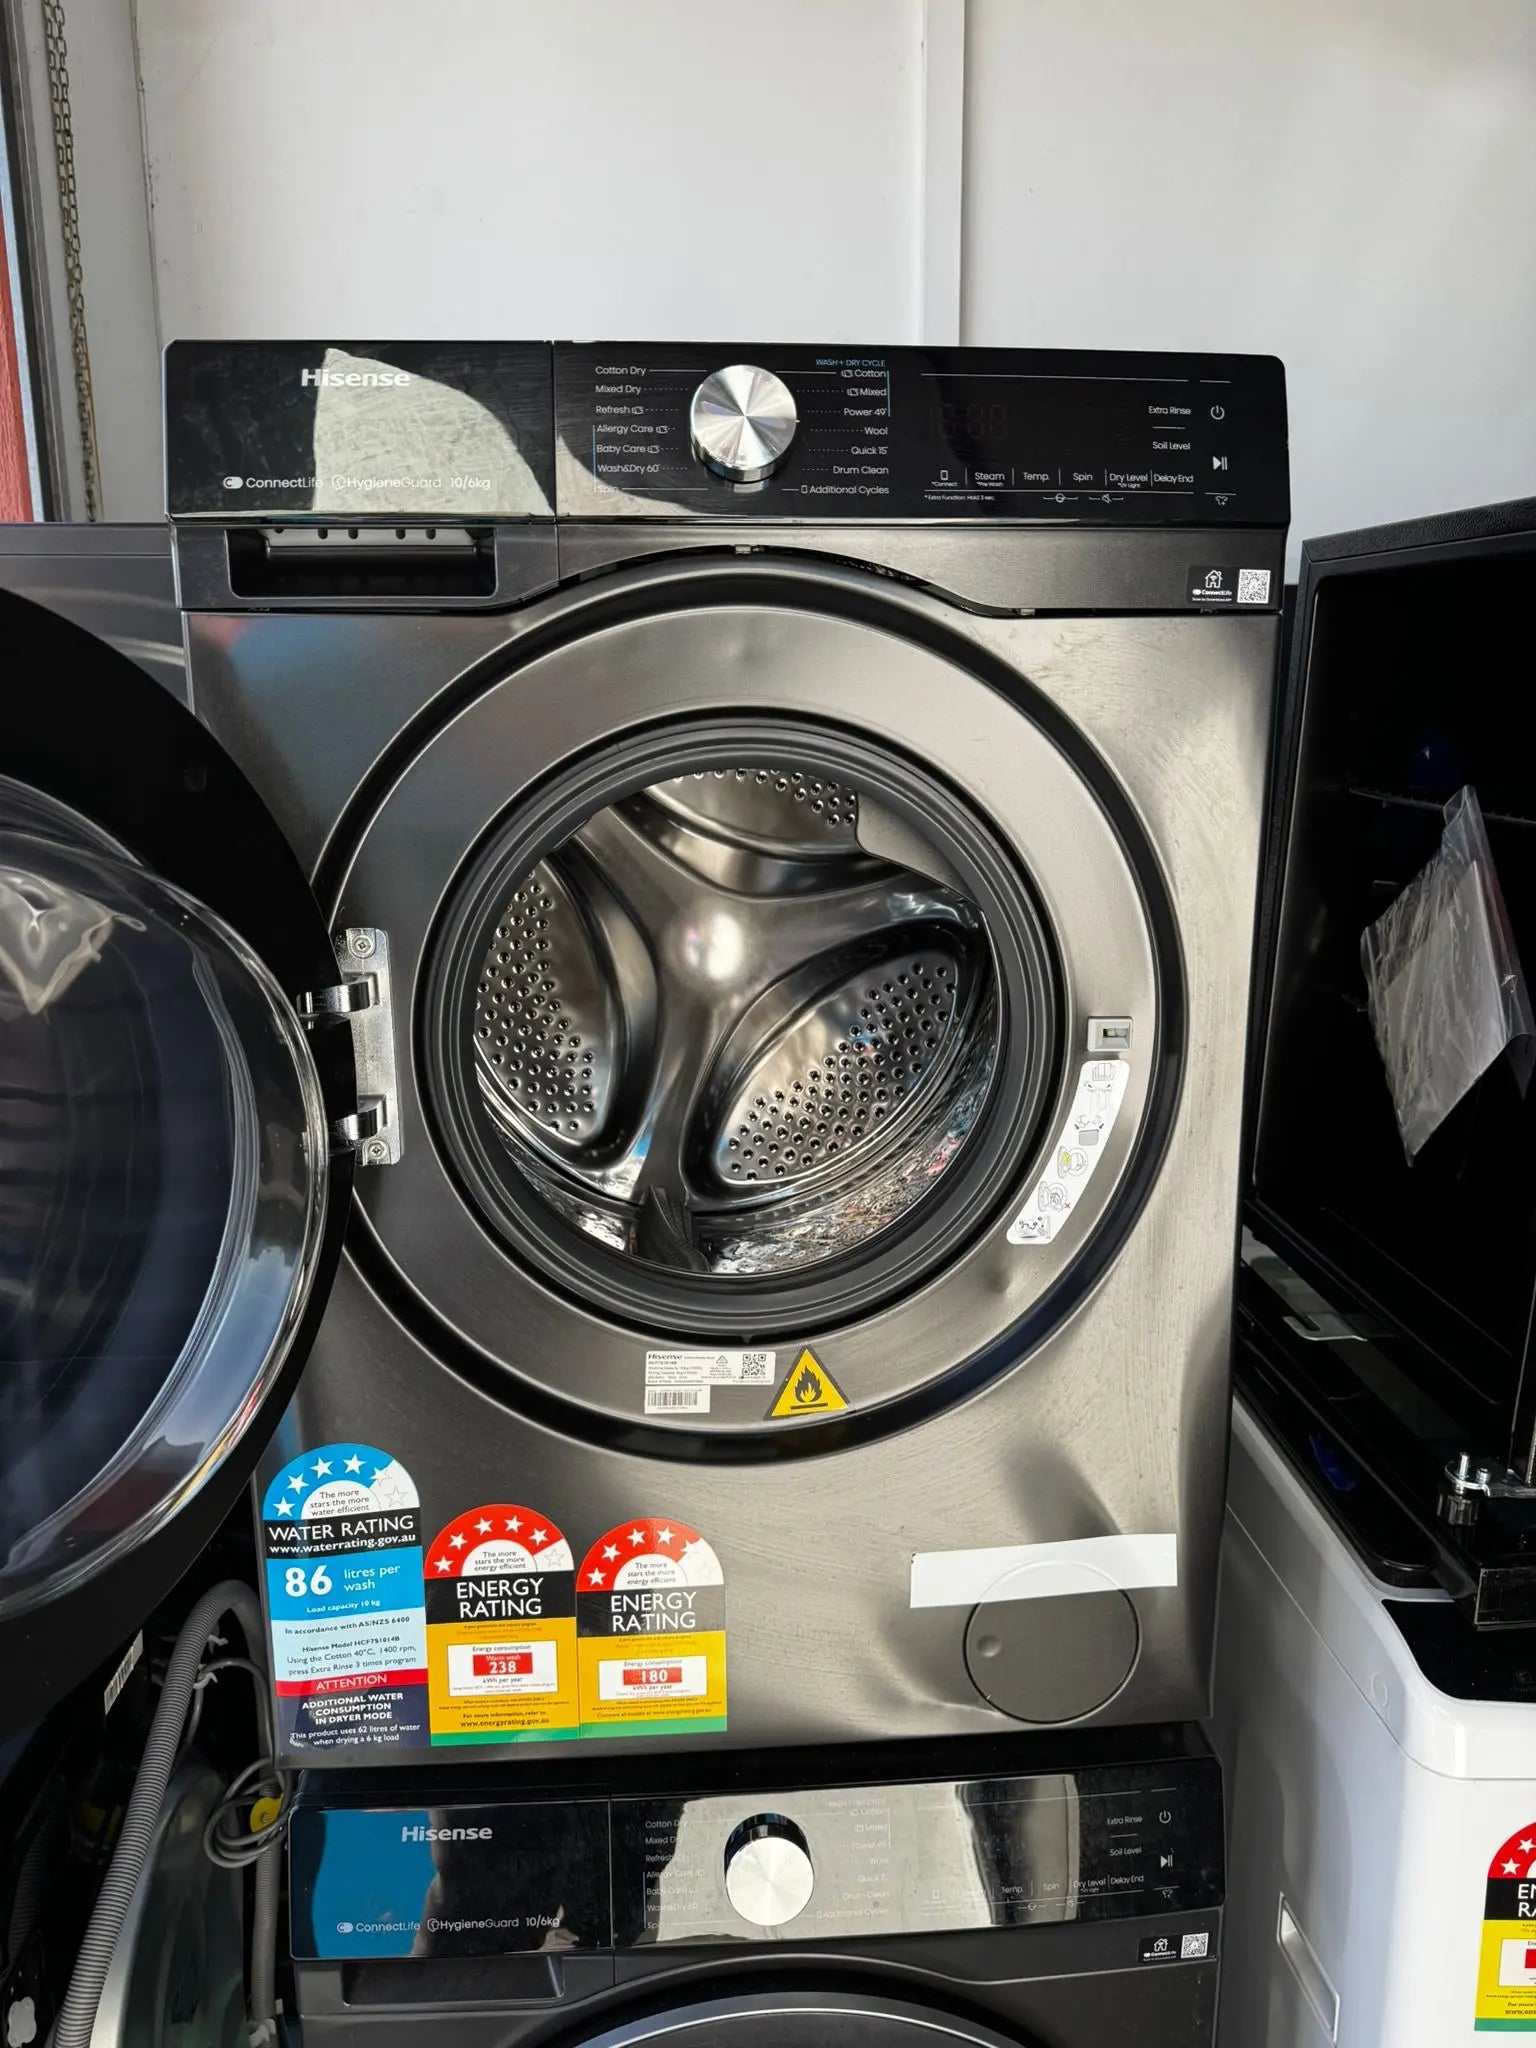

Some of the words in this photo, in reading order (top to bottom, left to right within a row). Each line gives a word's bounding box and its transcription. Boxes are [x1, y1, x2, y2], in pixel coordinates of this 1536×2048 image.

[845, 359, 861, 367] DRY
[301, 368, 411, 387] Hisense
[595, 366, 630, 375] Cotton
[631, 366, 646, 377] Dry
[854, 369, 887, 378] Cotton
[595, 384, 623, 394] Mixed
[625, 384, 641, 395] Dry
[860, 388, 887, 396] Mixed
[596, 405, 630, 414] Refresh
[844, 408, 872, 417] Power
[1149, 406, 1167, 415] Extra
[1169, 406, 1191, 415] Rinse
[597, 424, 631, 435] Allergy
[633, 425, 653, 434] Care
[864, 426, 888, 435] Wool
[597, 444, 620, 456] Baby
[622, 444, 646, 454] Care
[851, 446, 877, 456] Quick
[1152, 441, 1167, 450] Soil
[1169, 442, 1191, 451] Level
[597, 464, 645, 475] Wash&Dry
[833, 466, 857, 475] Drum
[858, 466, 889, 475] Clean
[974, 471, 1005, 481] Steam
[1023, 472, 1050, 483] Temp.
[1073, 472, 1093, 484] Spin
[1109, 473, 1124, 485] Dry
[1125, 473, 1148, 483] Level
[1154, 473, 1174, 485] Delay
[1174, 474, 1194, 484] End
[246, 475, 323, 490] ConnectLife
[347, 476, 442, 491] HygieneGuard
[450, 476, 491, 491] 10/6kg
[598, 485, 618, 495] Spin
[809, 485, 857, 495] Additional
[858, 485, 889, 497] Cycles
[320, 1491, 335, 1499] The
[337, 1489, 360, 1497] more
[310, 1501, 330, 1509] stars
[332, 1498, 346, 1506] the
[348, 1496, 370, 1504] more
[311, 1508, 335, 1517] water
[337, 1504, 370, 1514] efficient
[269, 1525, 335, 1541] WATER
[341, 1515, 414, 1537] RATING
[269, 1533, 416, 1553] www.waterrating.gov.au
[344, 1568, 375, 1579] litres
[380, 1564, 400, 1578] per
[499, 1562, 526, 1570] efficient
[285, 1564, 333, 1597] 86
[344, 1579, 376, 1592] wash
[626, 1578, 649, 1586] energy
[456, 1577, 544, 1599] ENERGY
[307, 1605, 326, 1613] Load
[327, 1602, 360, 1612] capacity
[361, 1600, 369, 1608] 10
[371, 1599, 381, 1608] kg
[610, 1591, 697, 1613] ENERGY
[460, 1598, 542, 1619] RATING
[285, 1627, 293, 1635] In
[294, 1626, 338, 1635] accordance
[340, 1622, 357, 1630] with
[358, 1618, 390, 1628] AS/NZS
[612, 1611, 696, 1632] RATING
[302, 1644, 330, 1653] Hisense
[331, 1641, 353, 1650] Model
[287, 1655, 308, 1665] Using
[324, 1651, 352, 1661] Cotton
[380, 1645, 398, 1654] 1400
[399, 1645, 416, 1655] rpm,
[288, 1668, 309, 1676] press
[311, 1665, 331, 1674] Extra
[333, 1662, 354, 1671] Rinse
[355, 1661, 360, 1669] 3
[362, 1659, 383, 1668] times
[384, 1657, 416, 1667] program
[489, 1661, 517, 1674] 238
[641, 1669, 668, 1683] 180
[316, 1674, 387, 1691] ATTENTION
[302, 1695, 367, 1710] ADDITIONAL
[368, 1692, 404, 1701] WATER
[315, 1702, 392, 1716] CONSUMPTION
[315, 1717, 327, 1725] IN
[329, 1713, 362, 1724] DRYER
[363, 1711, 393, 1720] MODE
[460, 1718, 550, 1728] www.energyrating.gov.au
[308, 1728, 338, 1739] product
[335, 1736, 359, 1745] drying
[373, 1735, 382, 1743] kg
[383, 1734, 400, 1742] load
[645, 1820, 672, 1829] Cotton
[1107, 1817, 1124, 1825] Extra
[1125, 1816, 1143, 1824] Rinse
[401, 1826, 493, 1842] Hisense
[645, 1836, 668, 1845] Mixed
[1110, 1848, 1123, 1856] Soil
[1124, 1846, 1142, 1855] Level
[1073, 1880, 1087, 1889] Dry
[1087, 1878, 1106, 1887] Level
[1110, 1876, 1130, 1885] Delay
[1131, 1875, 1144, 1884] End
[1042, 1882, 1060, 1892] Spin
[356, 1922, 421, 1933] ConnectLife
[440, 1917, 519, 1933] HygieneGuard
[525, 1916, 561, 1928] 10/6kg
